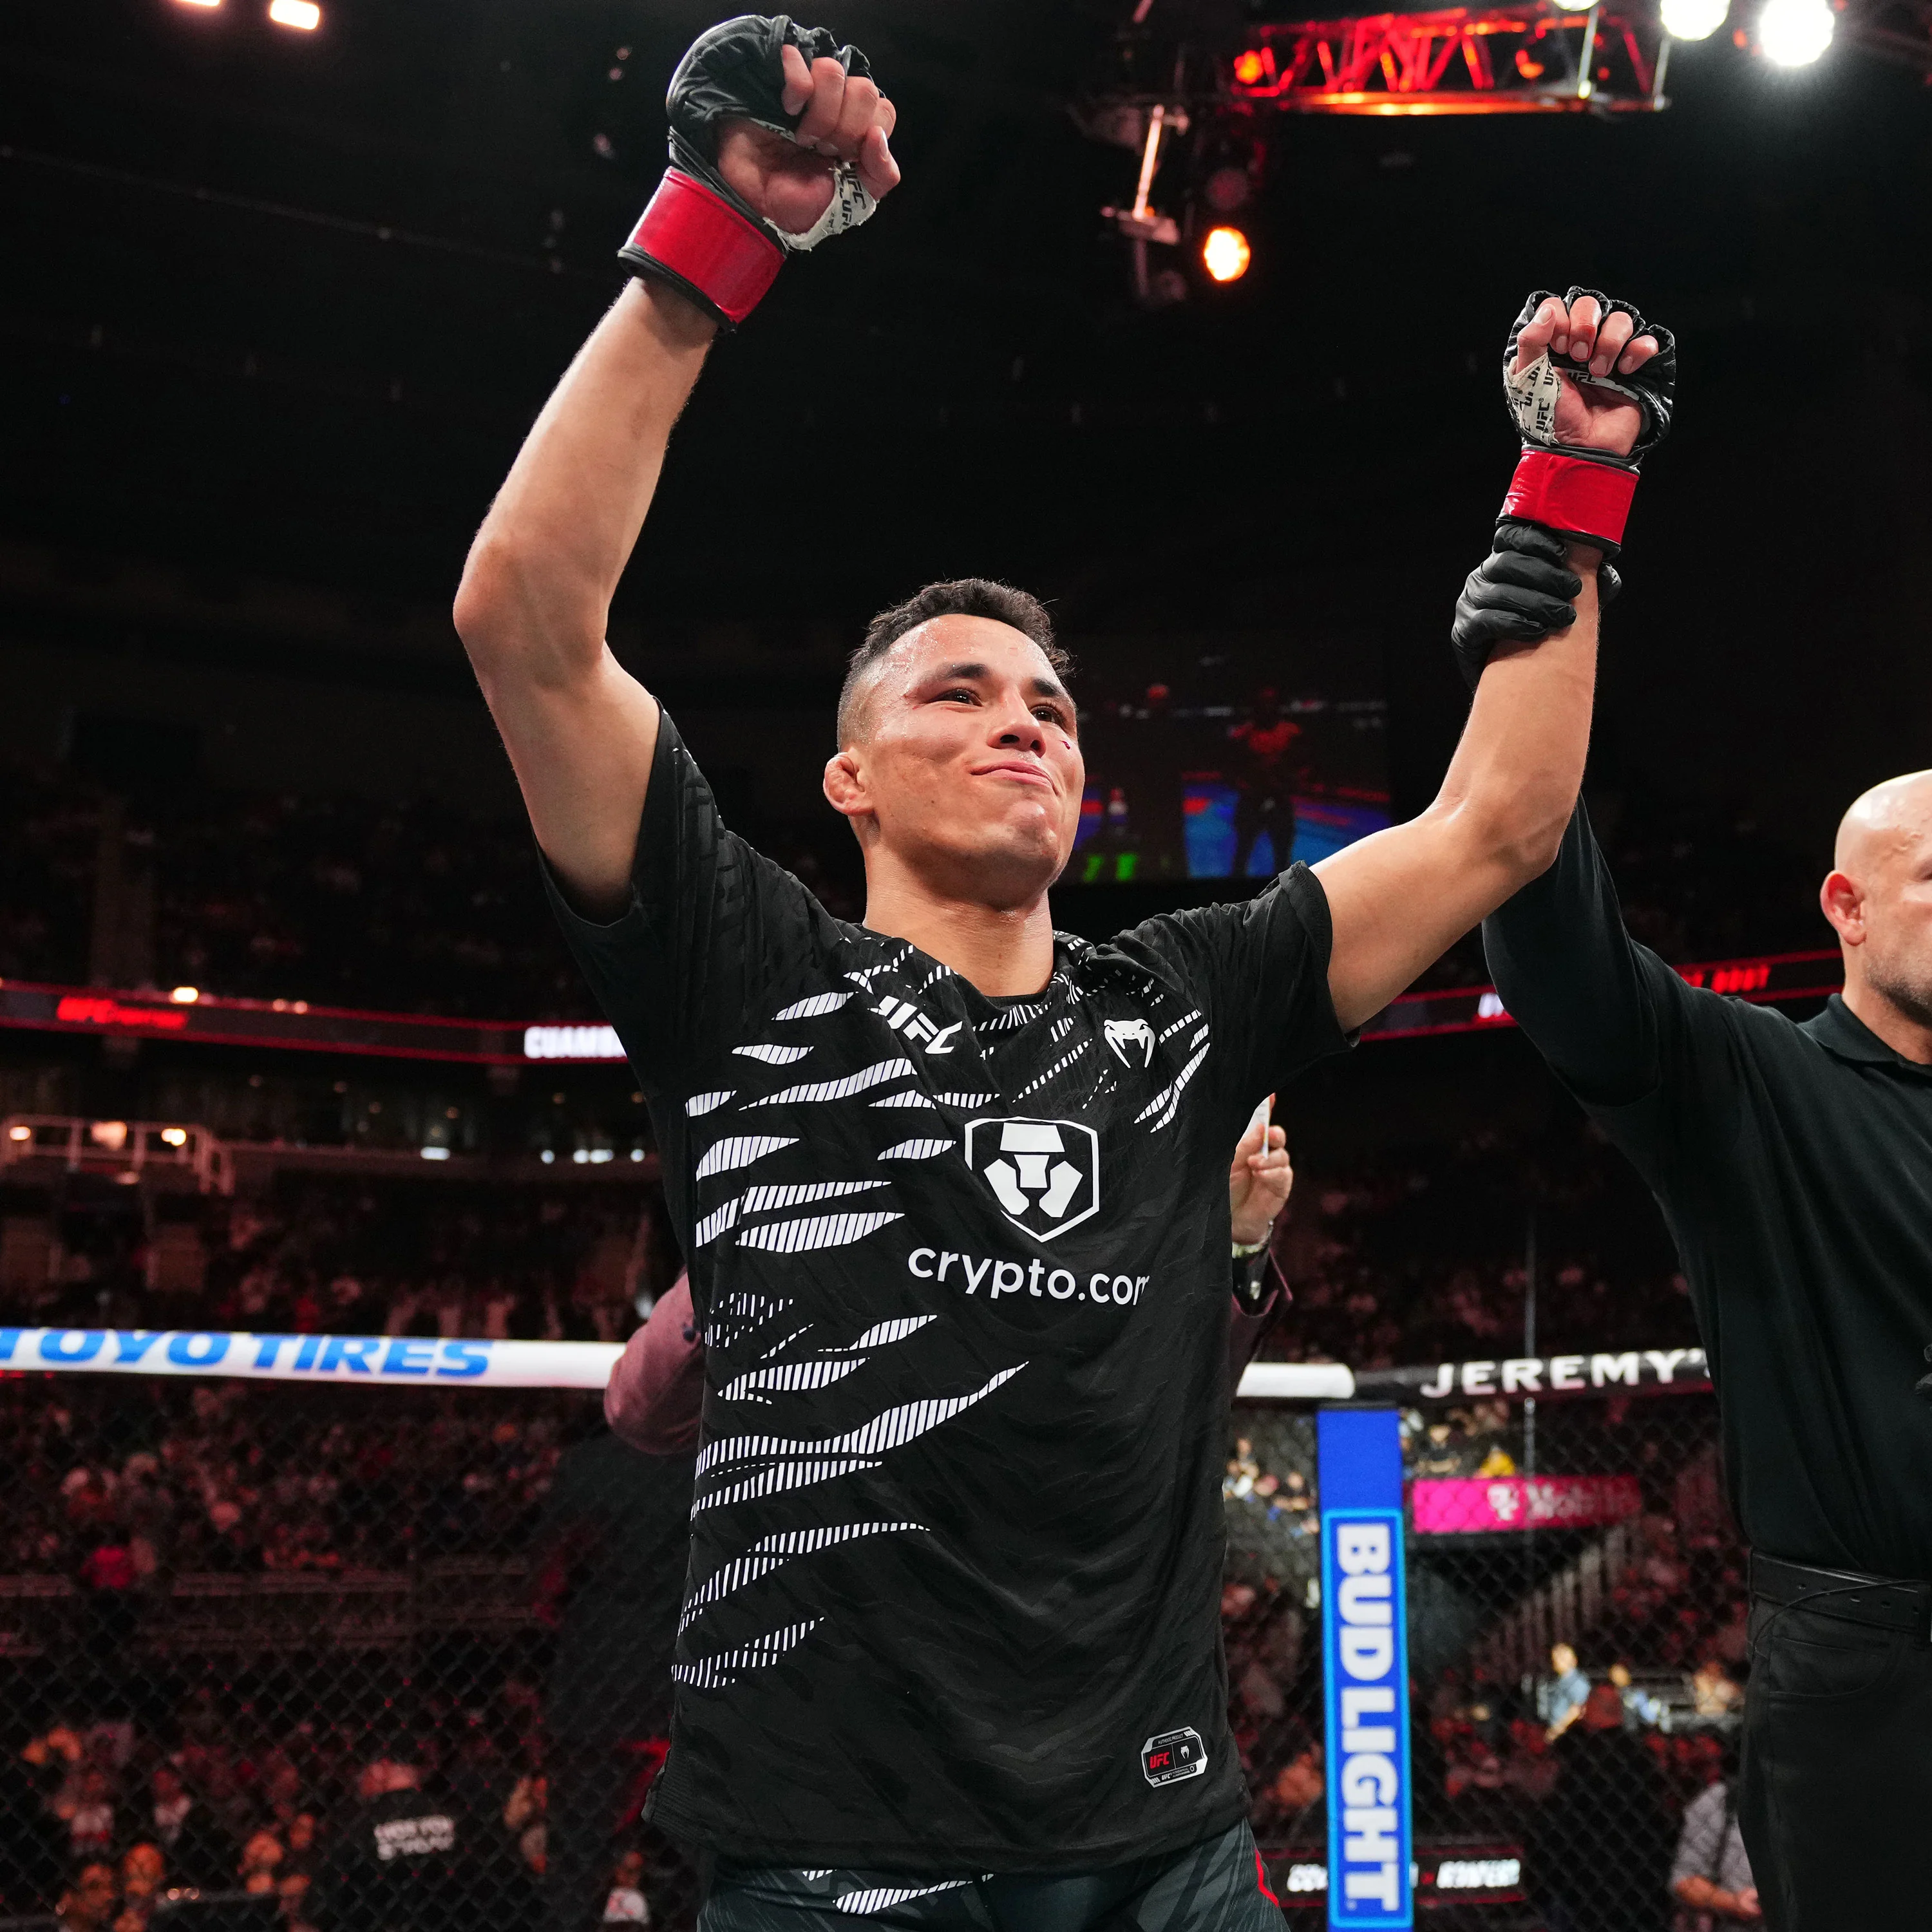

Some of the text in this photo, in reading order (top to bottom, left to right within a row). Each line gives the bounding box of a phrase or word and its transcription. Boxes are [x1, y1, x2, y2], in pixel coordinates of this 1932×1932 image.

[878, 995, 963, 1054] UFC
[250, 1332, 494, 1377] TIRES
[1419, 1347, 1710, 1398] JEREMY'
[1337, 1523, 1400, 1912] BUD LIGHT
[1150, 1752, 1170, 1769] UFC
